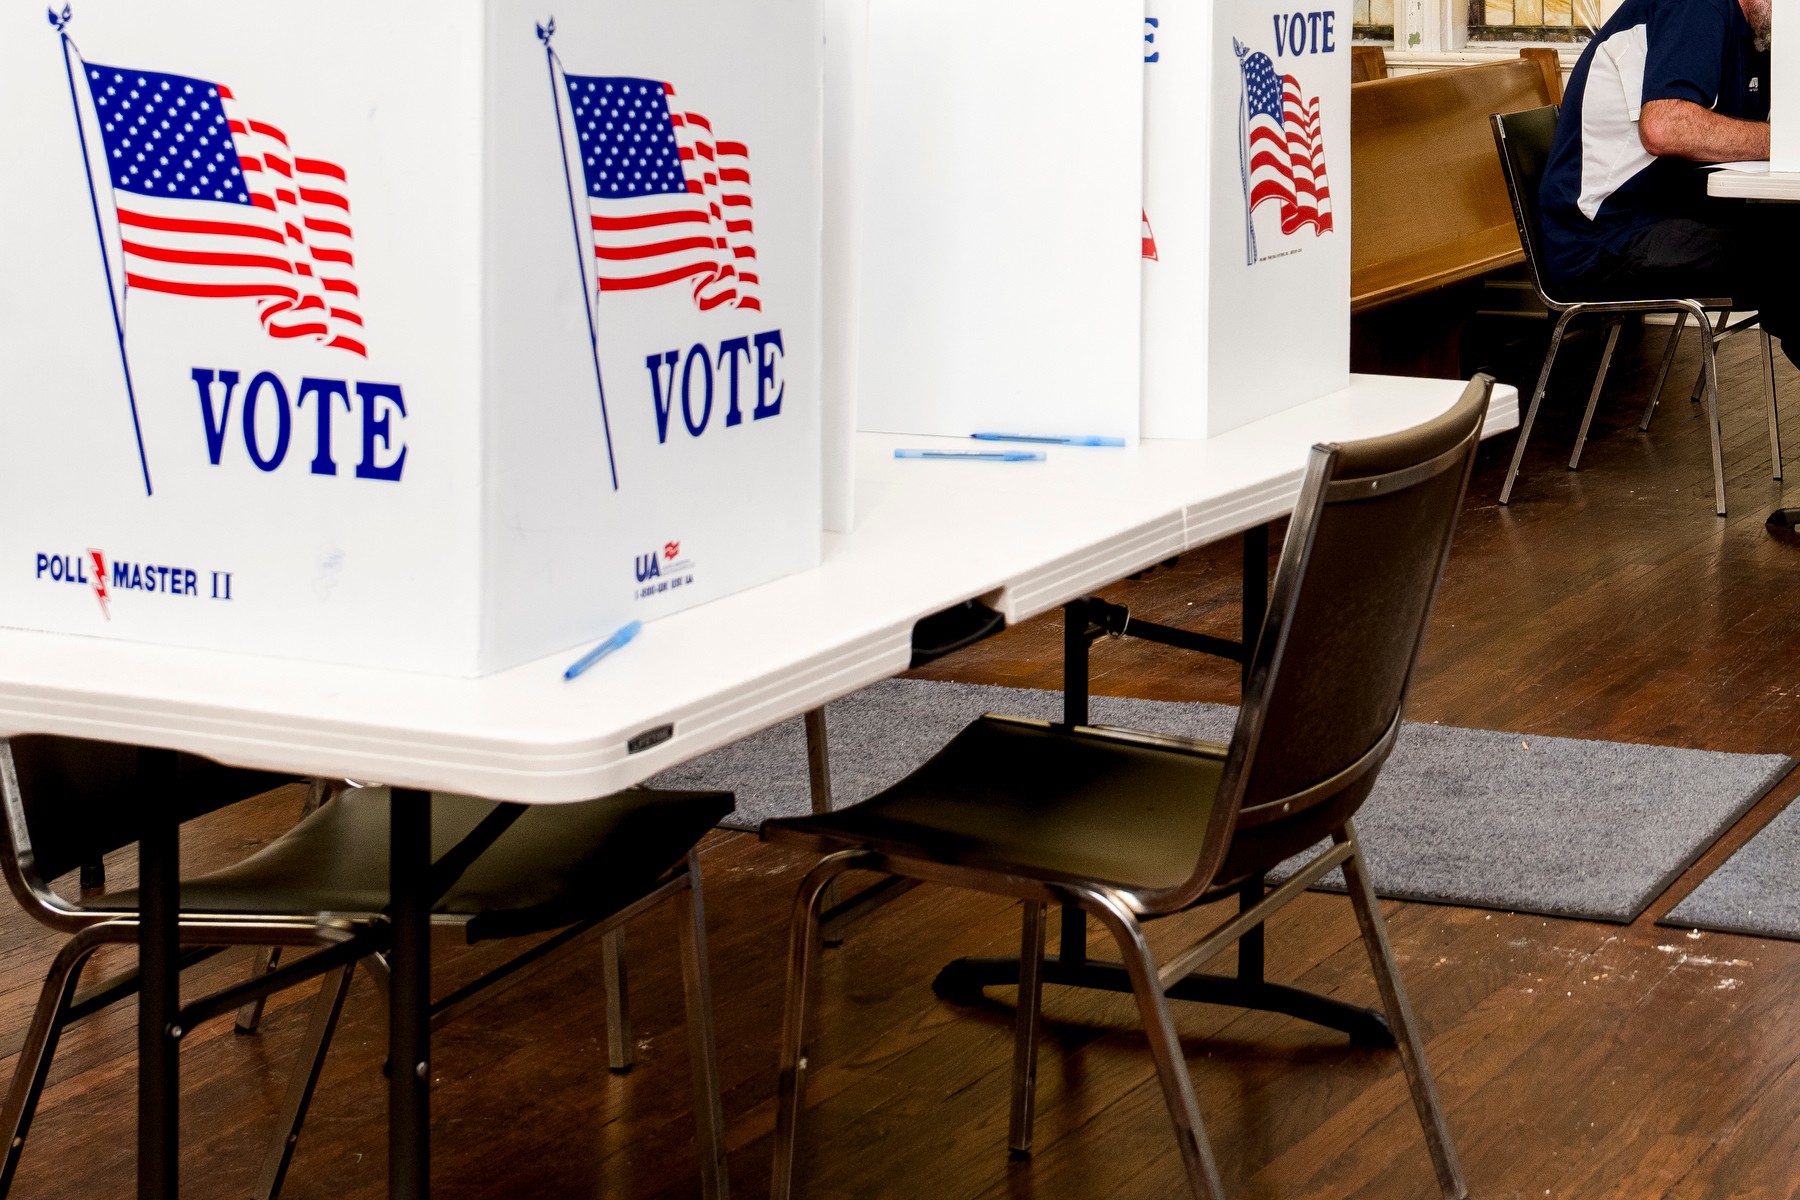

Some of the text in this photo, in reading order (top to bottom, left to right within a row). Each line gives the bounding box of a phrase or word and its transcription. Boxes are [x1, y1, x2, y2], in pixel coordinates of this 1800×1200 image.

[1273, 11, 1335, 58] VOTE
[645, 329, 785, 445] VOTE
[191, 367, 409, 483] VOTE
[36, 552, 236, 601] POLL MASTER II
[636, 551, 660, 583] UA
